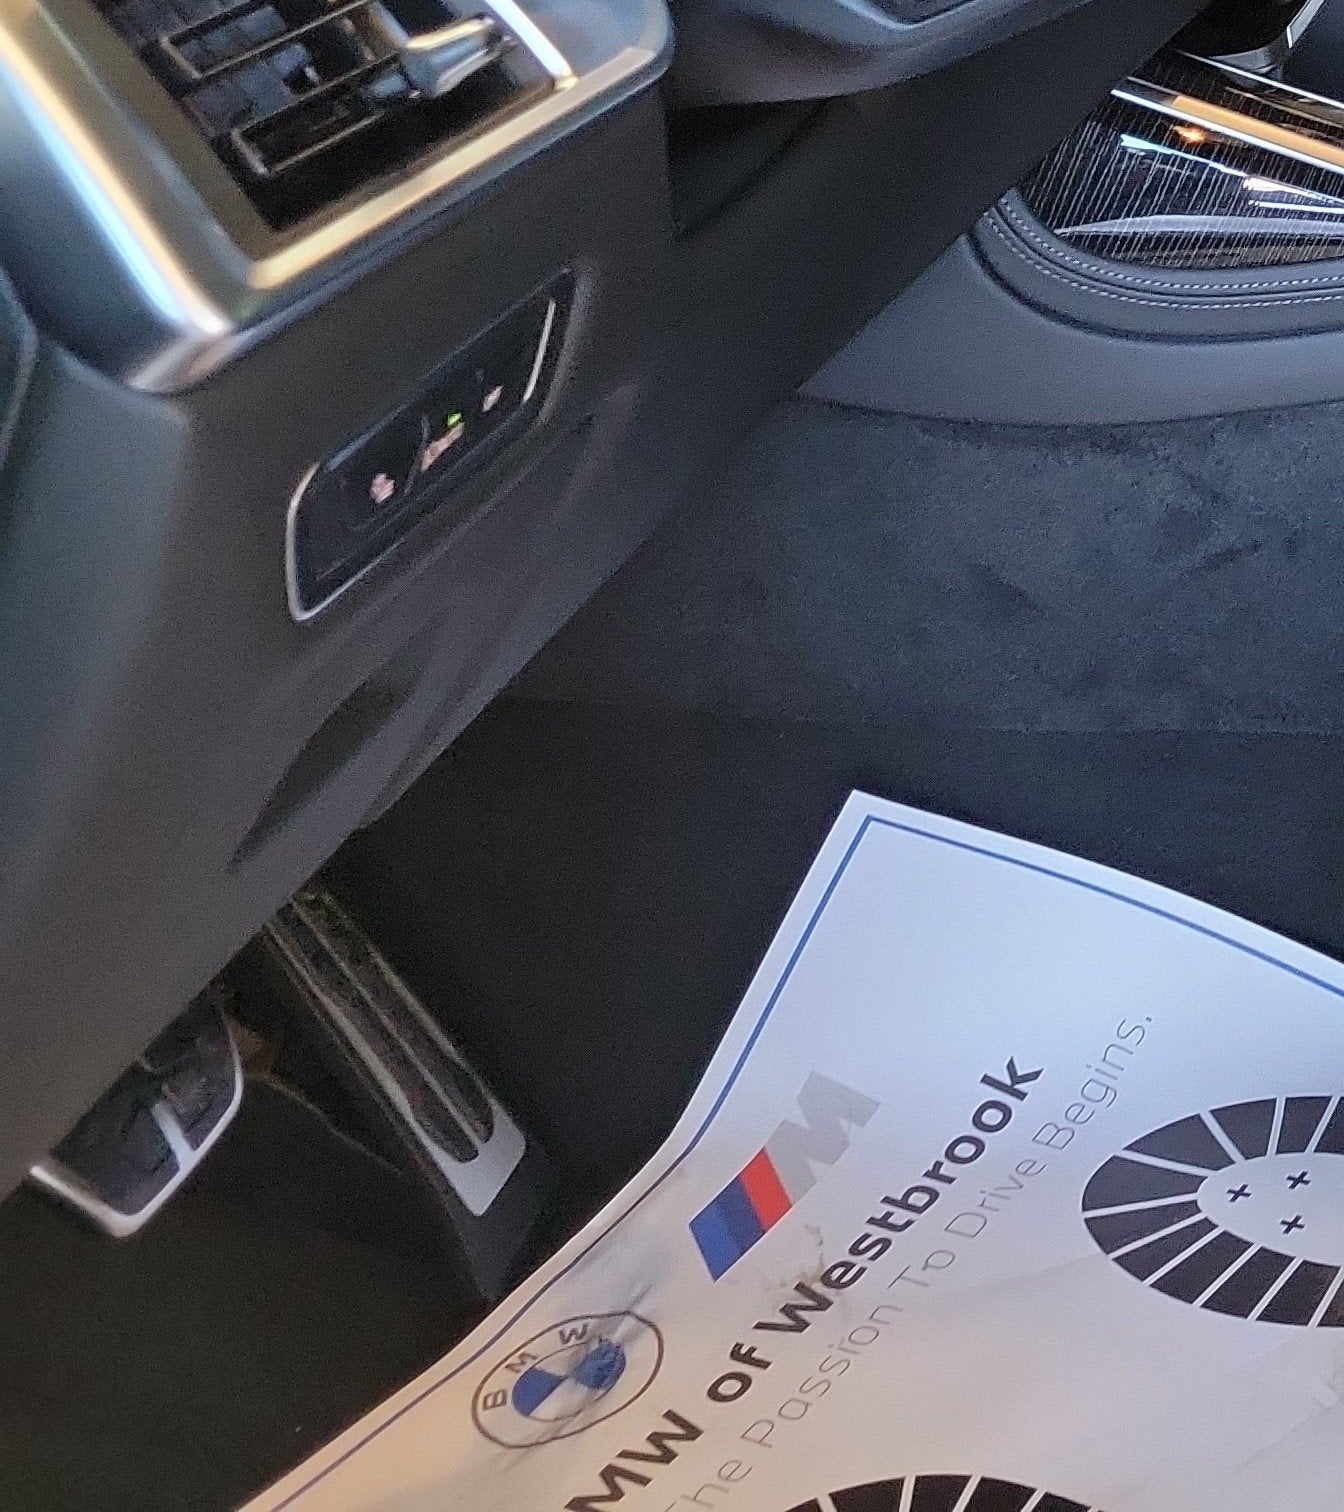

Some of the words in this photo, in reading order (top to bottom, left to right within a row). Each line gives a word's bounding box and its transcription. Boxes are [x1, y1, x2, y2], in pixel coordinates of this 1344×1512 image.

[481, 1324, 590, 1412] BMW
[563, 1409, 704, 1512] MW
[705, 1342, 773, 1403] of
[752, 1056, 1044, 1334] Westbrook
[741, 1304, 904, 1449] Passion
[886, 1247, 957, 1290] To
[944, 1157, 1049, 1240] Drive
[1032, 1012, 1153, 1152] Begins.
